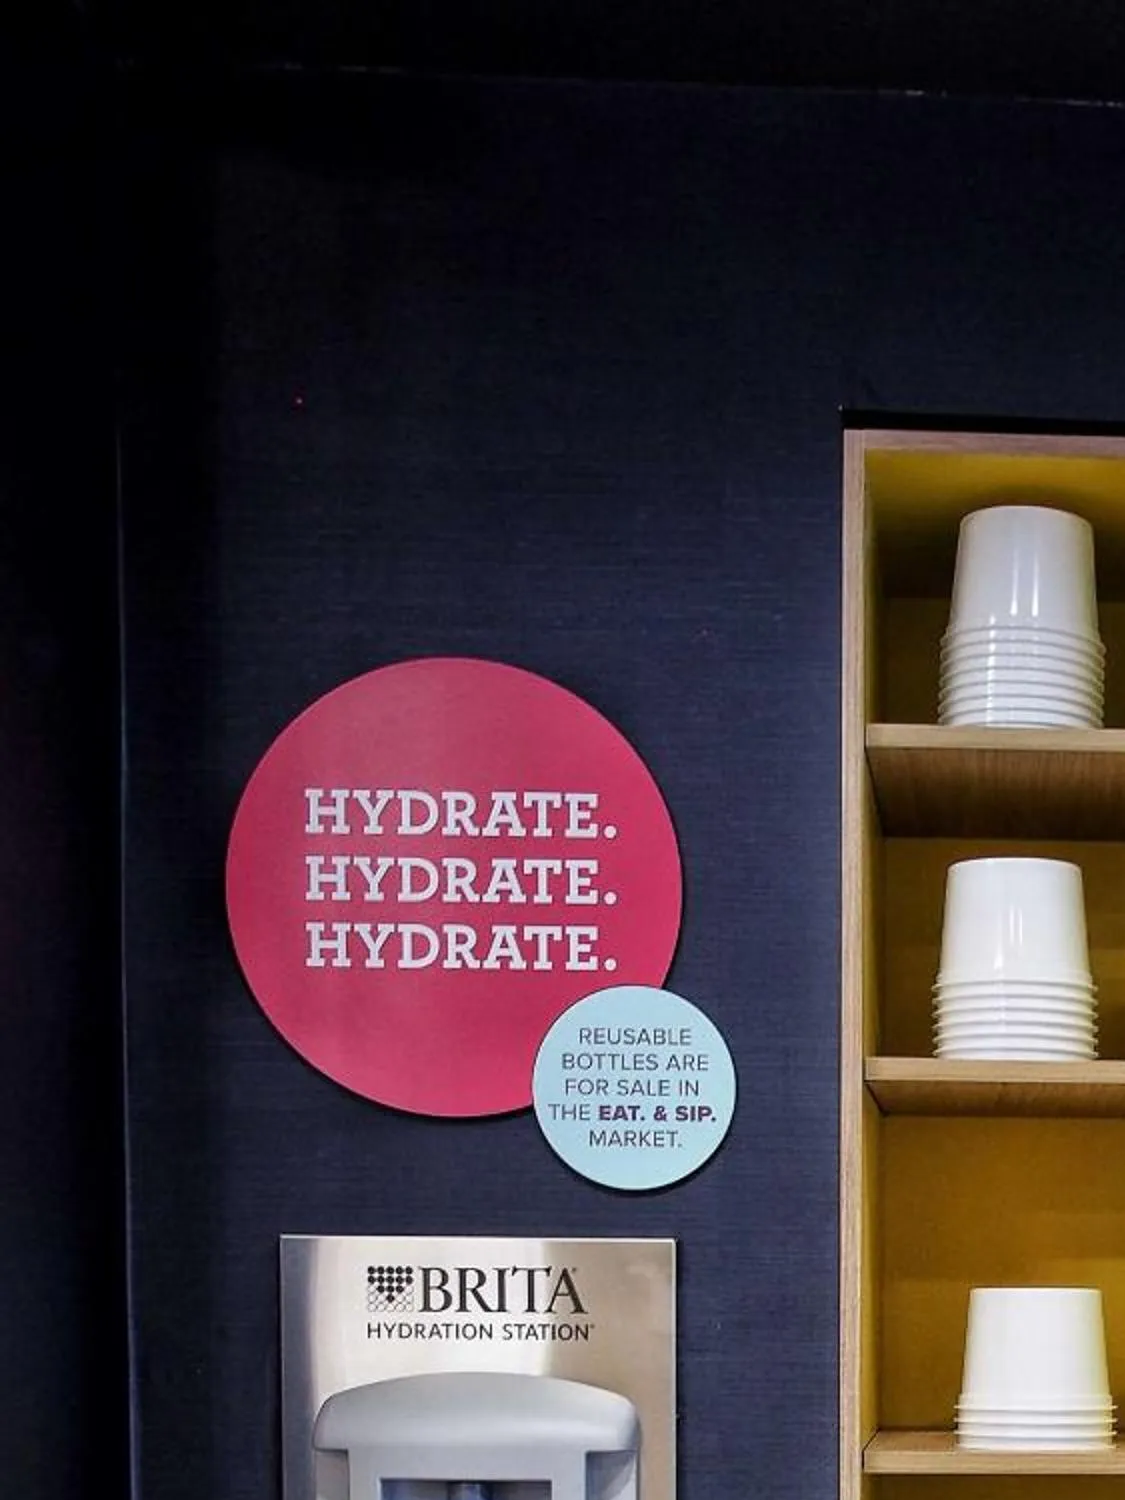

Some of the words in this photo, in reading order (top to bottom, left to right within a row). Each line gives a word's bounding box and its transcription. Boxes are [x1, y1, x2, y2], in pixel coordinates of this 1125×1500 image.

[305, 789, 617, 839] HYDRATE.
[305, 855, 617, 905] HYDRATE.
[305, 922, 617, 972] HYDRATE.
[578, 1027, 692, 1046] REUSABLE
[561, 1053, 660, 1071] BOTTLES
[665, 1054, 709, 1072] ARE
[564, 1078, 609, 1096] FOR
[616, 1079, 671, 1097] SALE
[678, 1080, 700, 1097] IN
[548, 1103, 591, 1121] THE
[598, 1105, 645, 1121] EAT.
[653, 1105, 668, 1121] &
[675, 1105, 717, 1122] SIP.
[588, 1129, 684, 1148] MARKET.
[418, 1265, 589, 1314] BRITA
[366, 1322, 494, 1340] HYDRATION
[502, 1323, 590, 1341] STATION
